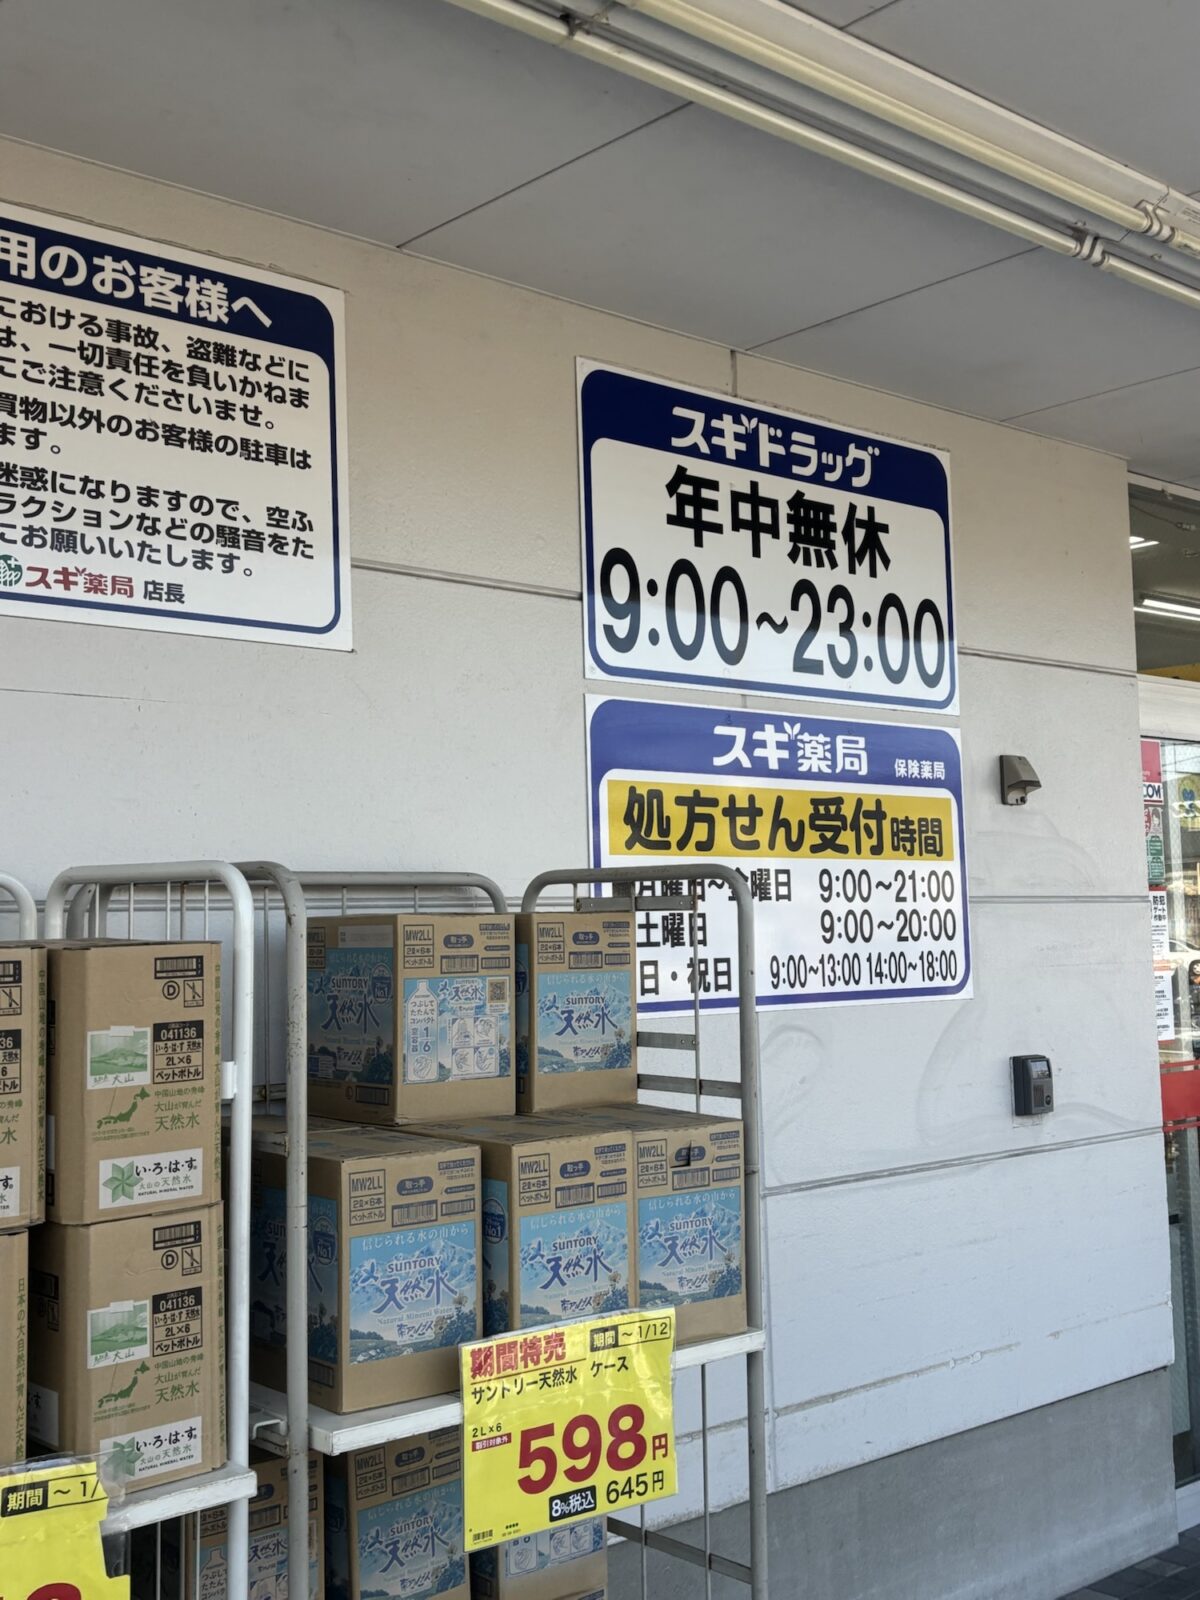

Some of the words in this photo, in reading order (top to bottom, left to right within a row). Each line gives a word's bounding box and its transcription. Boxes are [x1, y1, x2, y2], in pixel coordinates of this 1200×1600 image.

[0, 229, 272, 328] 用のお客様へ
[671, 405, 880, 488] スギドラッグ
[665, 464, 891, 579] 年中無休
[25, 565, 134, 599] スギ薬局
[143, 579, 185, 604] 店長
[713, 720, 868, 775] スギ薬局
[894, 758, 946, 780] 保険薬局
[405, 929, 432, 941] MW2LL
[637, 912, 708, 948] 土曜日
[160, 1027, 197, 1041] 041136
[155, 1112, 200, 1132] 天然水
[638, 1145, 666, 1159] MW2LL
[520, 1159, 548, 1175] MW2LL
[351, 1177, 383, 1193] MW2LL
[669, 1216, 714, 1232] SUNTORY
[552, 1235, 599, 1252] SUNTORY
[657, 1228, 728, 1268] 天然水
[388, 1255, 442, 1274] SUNTORY
[540, 1249, 613, 1290] 天然水
[159, 1295, 196, 1312] 041136
[373, 1268, 458, 1314] 天然水
[470, 1331, 566, 1379] 期間特売
[593, 1329, 616, 1348] 期間
[155, 1380, 200, 1405] 天然水
[471, 1365, 578, 1404] サントリー天然水
[590, 1356, 629, 1378] ケース
[356, 1455, 384, 1470] MW2LL
[7, 1488, 44, 1512] 期間
[551, 1492, 595, 1518] 8%税込
[390, 1514, 435, 1536] SUNTORY
[379, 1526, 449, 1573] 天然水
